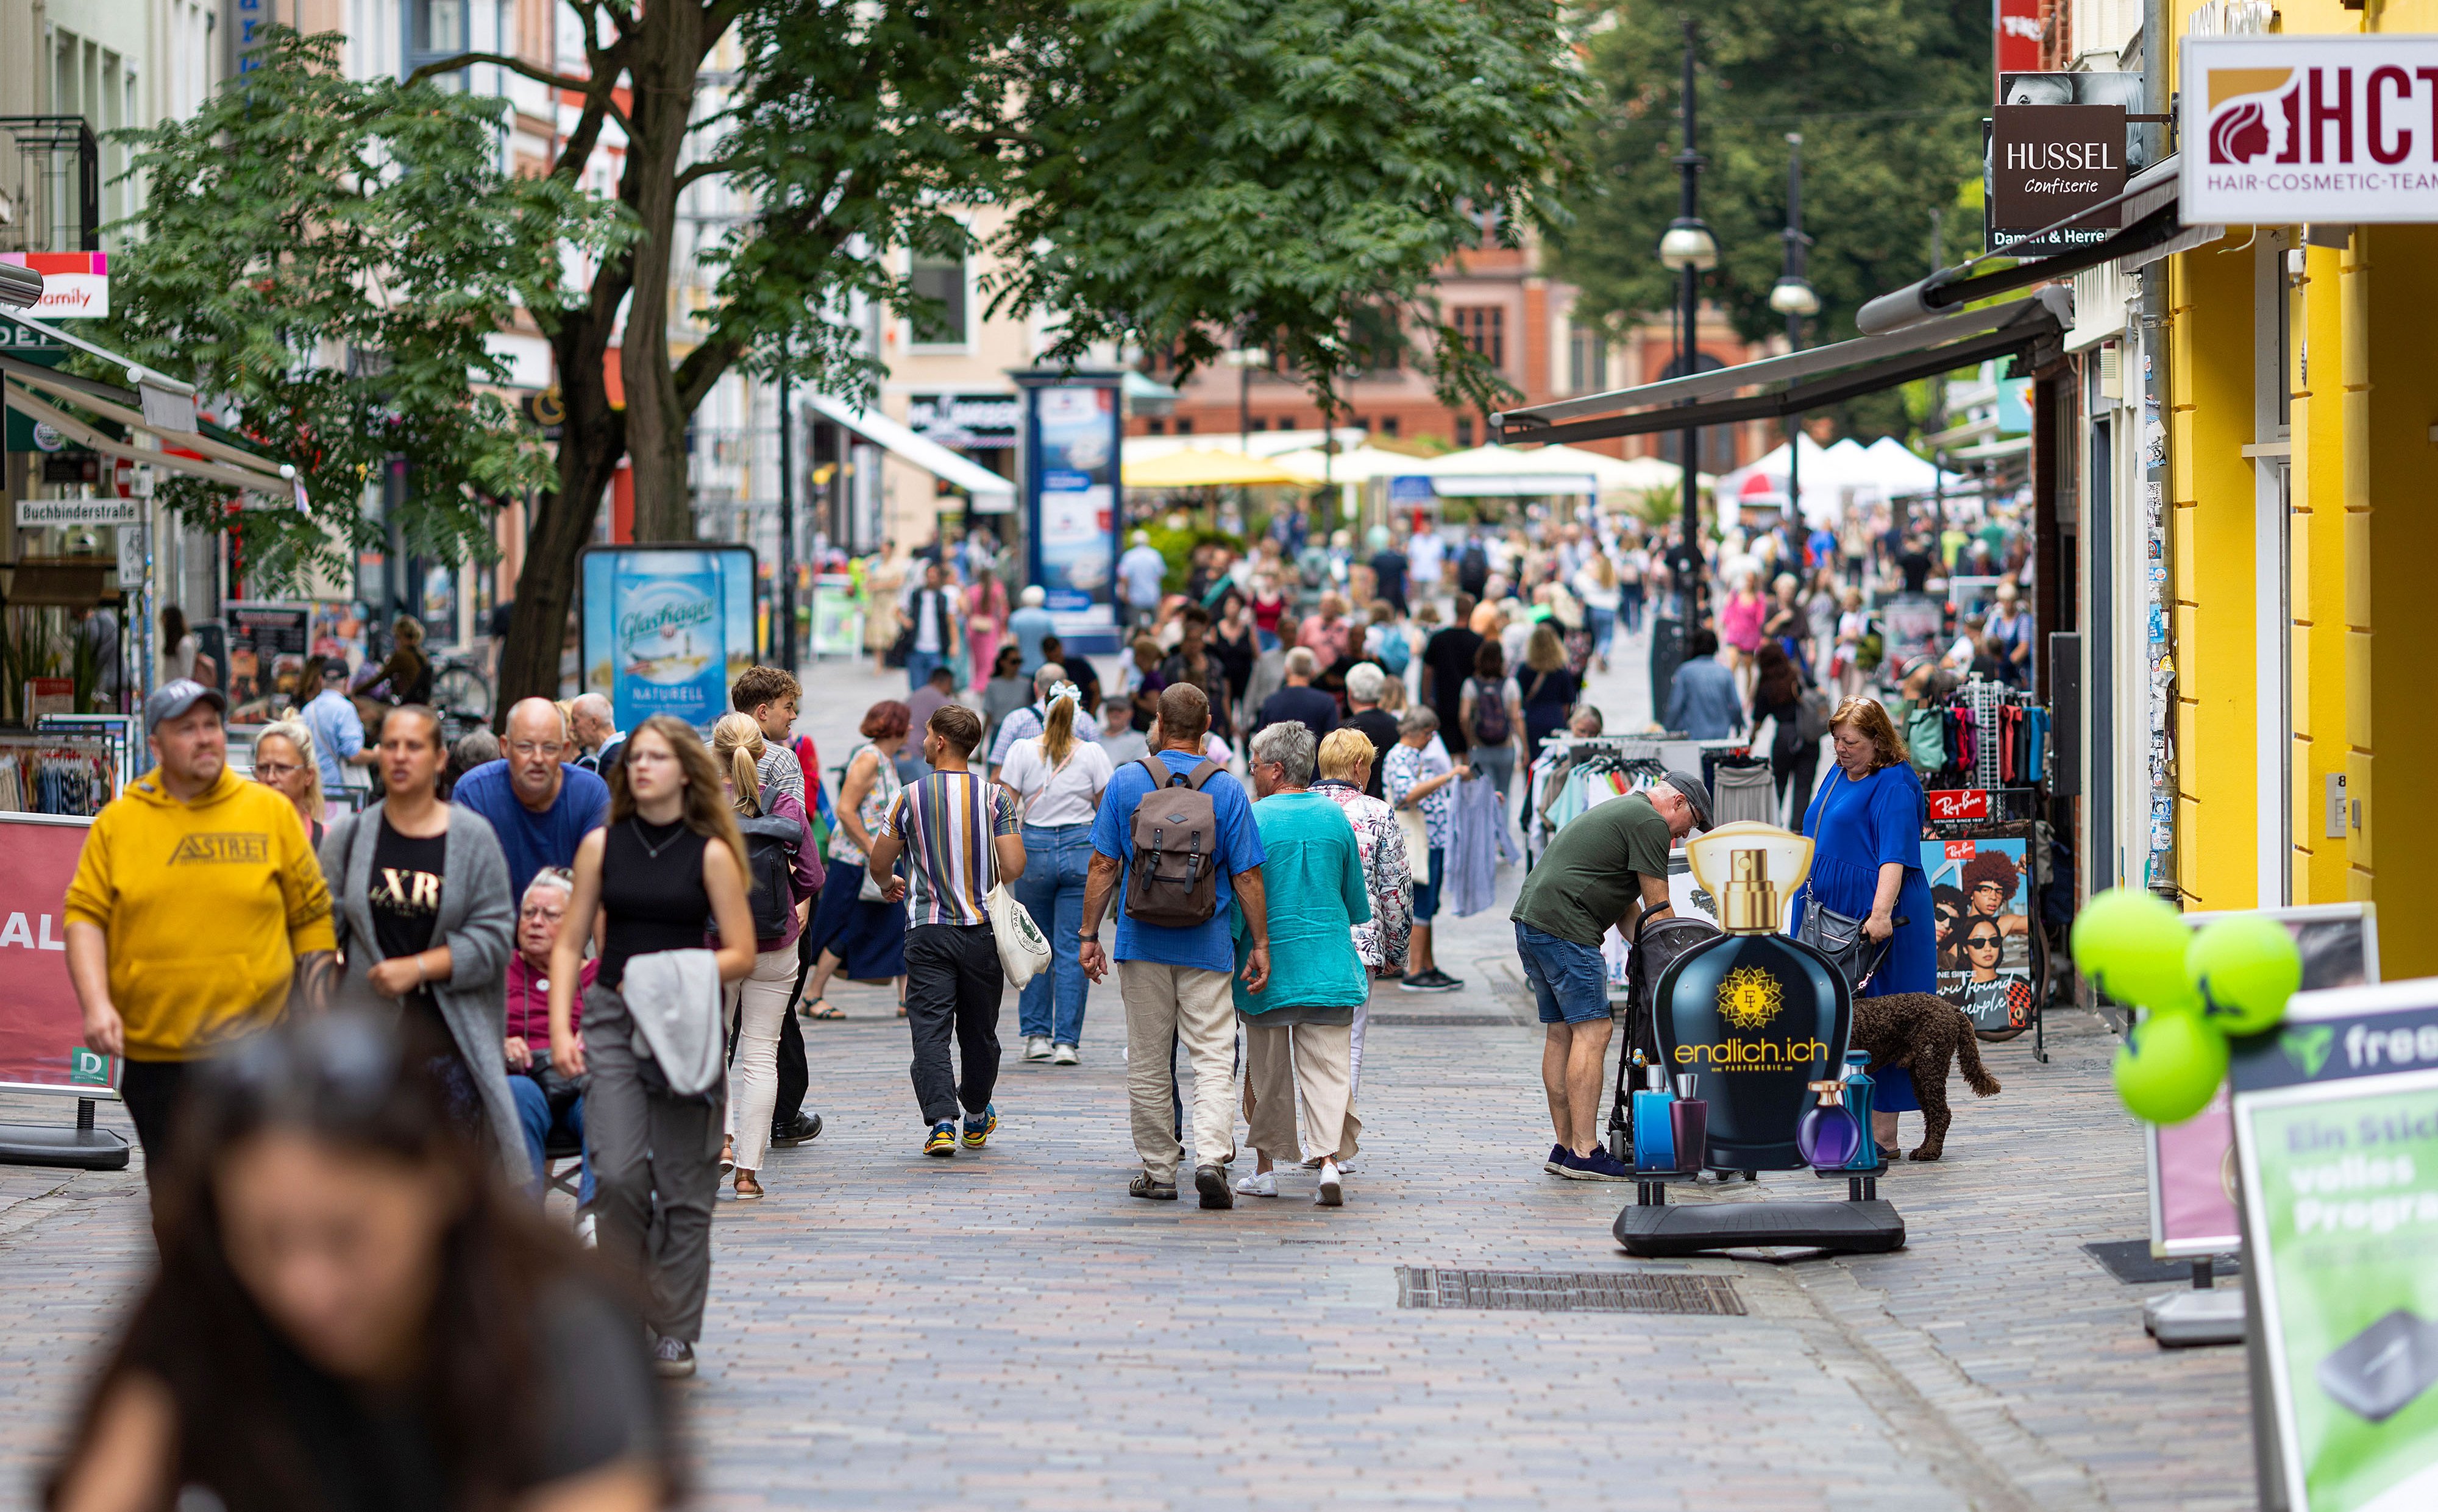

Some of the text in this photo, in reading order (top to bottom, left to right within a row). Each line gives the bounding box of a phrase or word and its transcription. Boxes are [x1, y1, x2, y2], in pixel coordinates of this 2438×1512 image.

[2007, 143, 2118, 170] HUSSEL
[2024, 178, 2099, 194] Confiserie
[2064, 228, 2107, 243] Herre
[23, 502, 135, 522] Buchbinderstraße
[633, 686, 704, 701] NATURELL
[1964, 970, 2014, 1000] found
[1674, 1037, 1828, 1063] endlich.ich
[80, 1052, 102, 1074] D
[2359, 1109, 2438, 1146] Stic
[2291, 1155, 2415, 1191] volles
